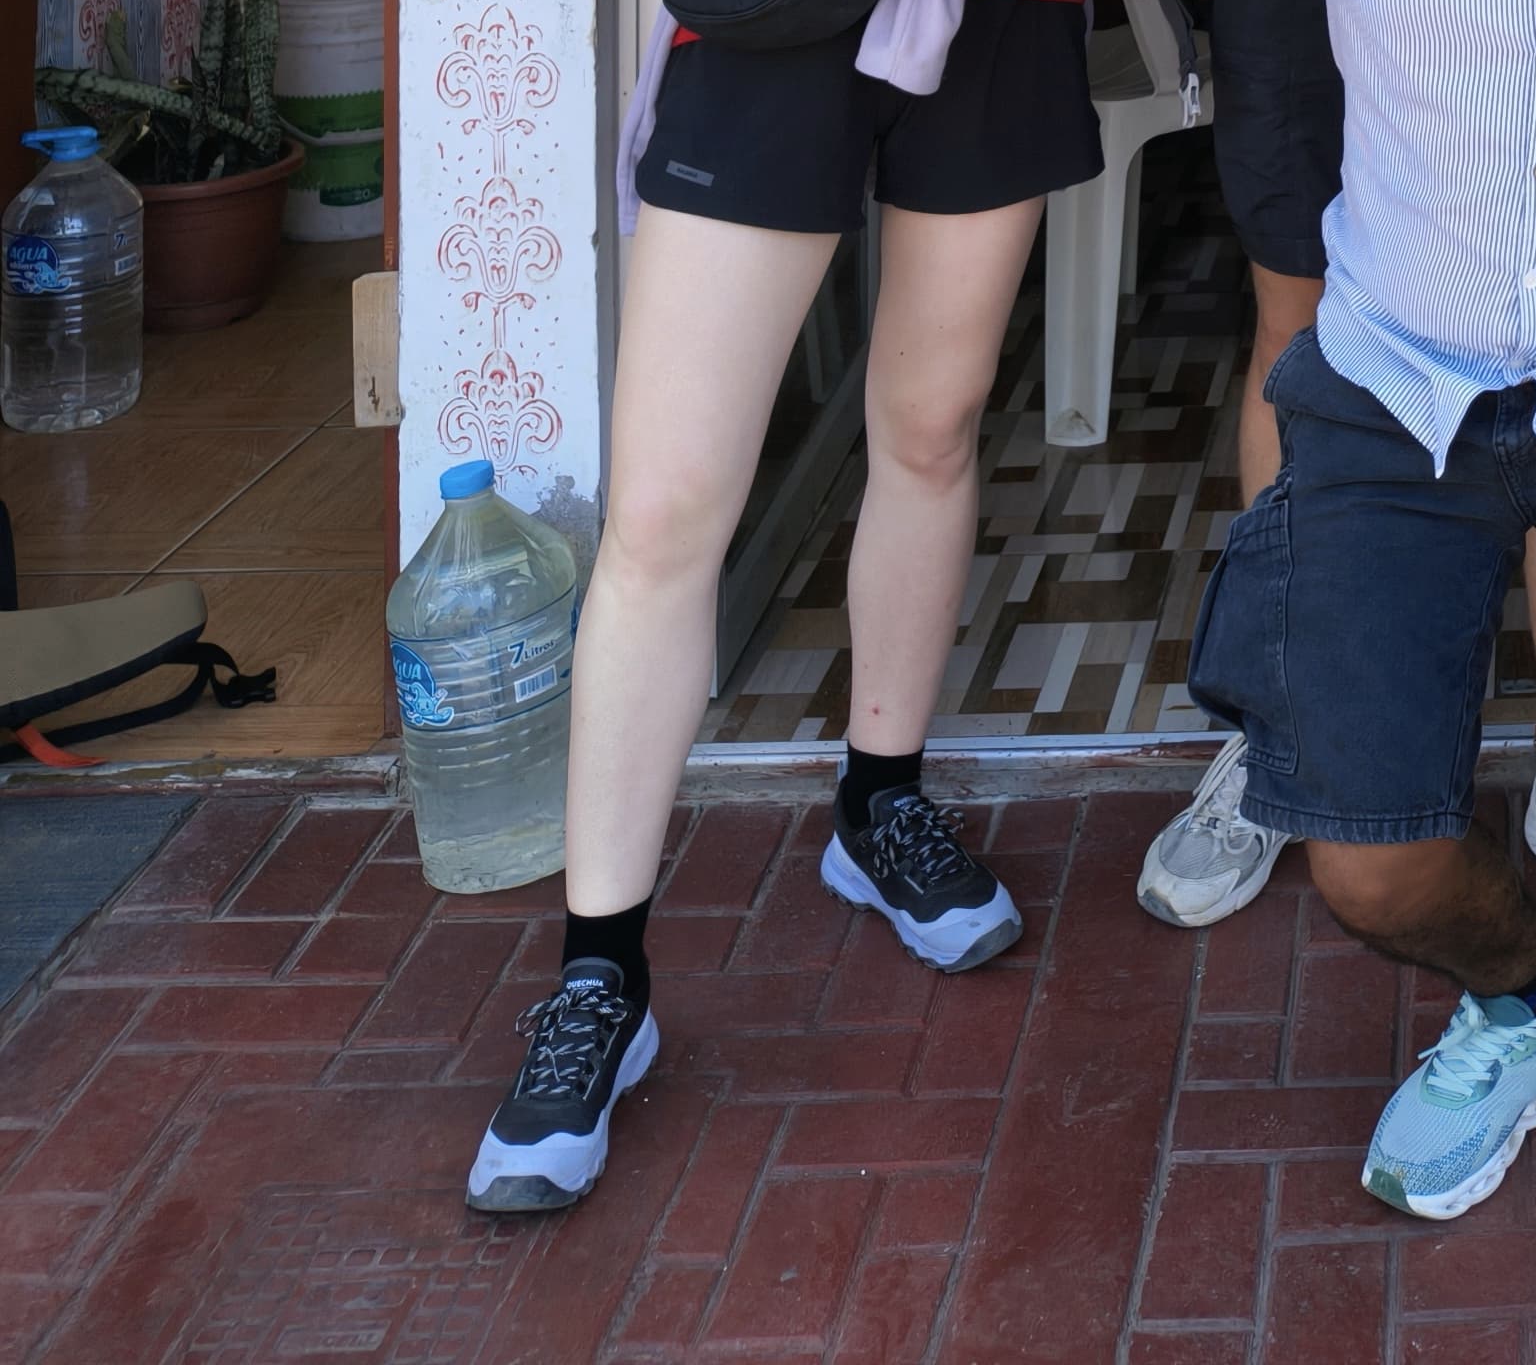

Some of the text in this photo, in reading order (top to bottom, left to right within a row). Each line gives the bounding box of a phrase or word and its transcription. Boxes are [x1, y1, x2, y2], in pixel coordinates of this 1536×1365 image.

[508, 639, 526, 669] 7
[395, 657, 421, 681] GUA
[566, 979, 604, 990] QUECHUA
